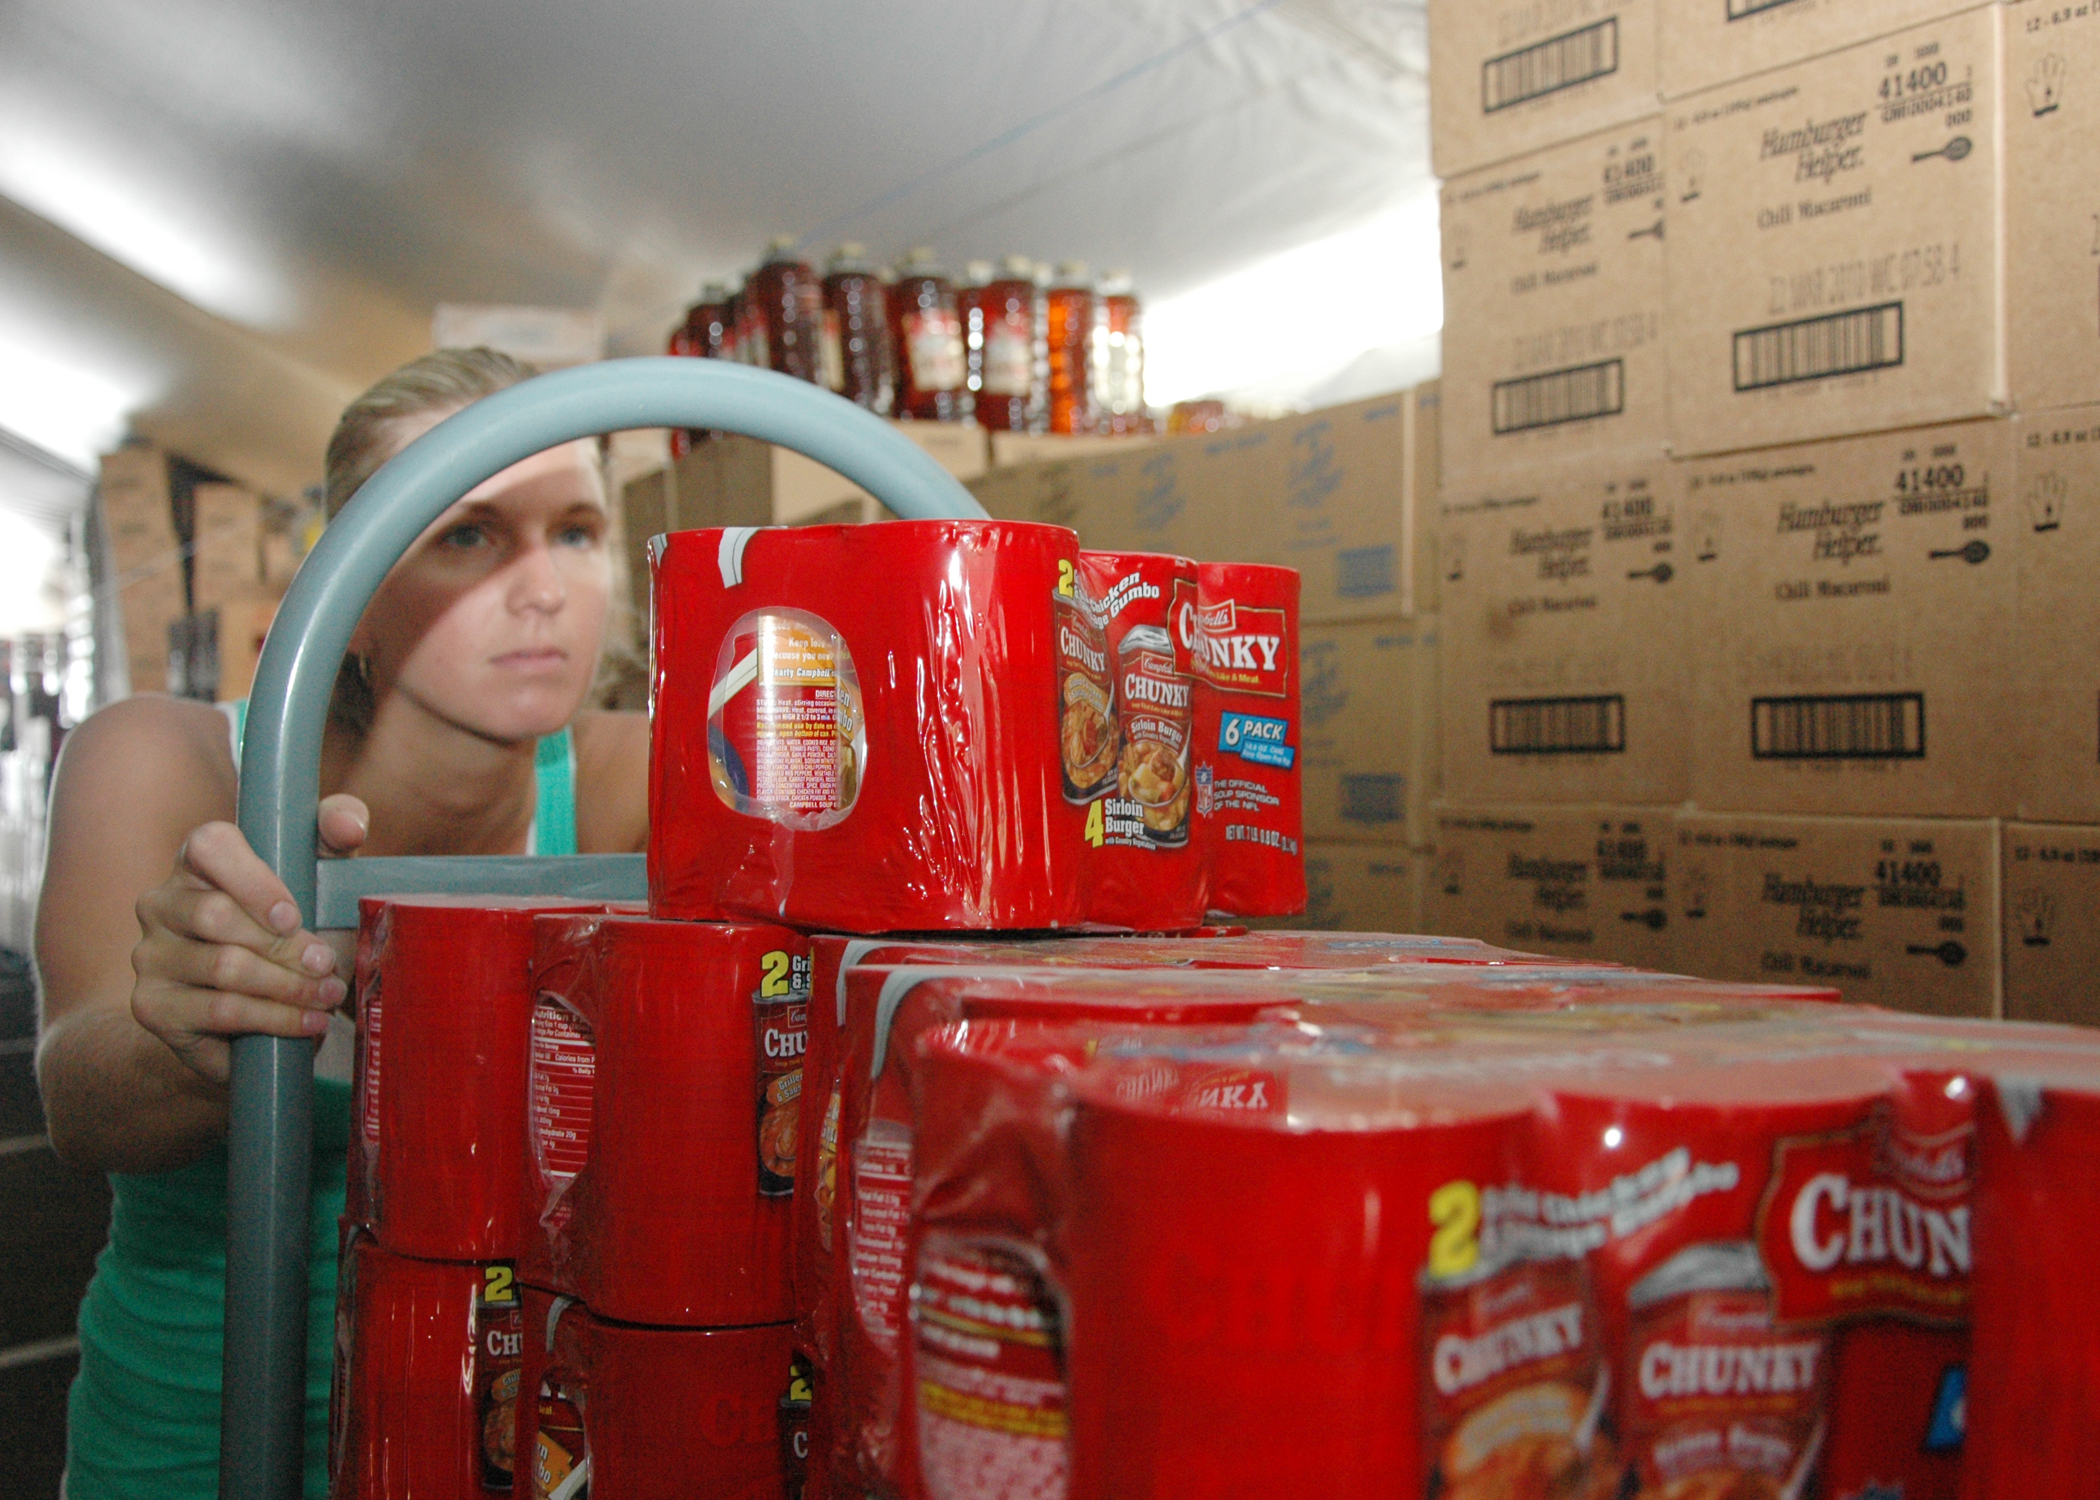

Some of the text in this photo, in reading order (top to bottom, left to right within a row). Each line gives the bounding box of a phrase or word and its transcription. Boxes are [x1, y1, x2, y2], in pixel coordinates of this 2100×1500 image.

[1878, 60, 1948, 100] 41400
[1759, 111, 1869, 161] Hamburger
[1757, 185, 1873, 229] Chili Macaroni
[1896, 464, 1965, 492] 41400
[1776, 499, 1884, 533] Hamburger
[1058, 558, 1075, 598] 2
[1109, 581, 1160, 619] Gumbo
[802, 652, 816, 663] you
[1060, 626, 1106, 673] CHUNKY
[1124, 673, 1190, 708] CHUNKY
[1131, 719, 1183, 743] Sirloin Burger
[1224, 718, 1284, 746] 6 PACK
[1213, 789, 1280, 807] SOUP SPONSOR
[1214, 779, 1268, 794] THE OFFICIAL
[1084, 798, 1144, 849] 4 Sirloin
[1213, 800, 1260, 812] OF THE NFL
[1105, 816, 1146, 838] Burger
[761, 950, 790, 998] 2
[792, 972, 802, 990] &
[555, 1053, 577, 1064] Calories
[577, 1054, 589, 1064] from
[764, 1028, 809, 1058] CHU
[578, 1067, 591, 1076] Daily
[1428, 1178, 1482, 1280] 2
[1789, 1172, 1972, 1278] CHUN
[484, 1265, 514, 1302] 2
[1433, 1301, 1583, 1396] CHUNKY
[1639, 1339, 1823, 1400] CHUNKY
